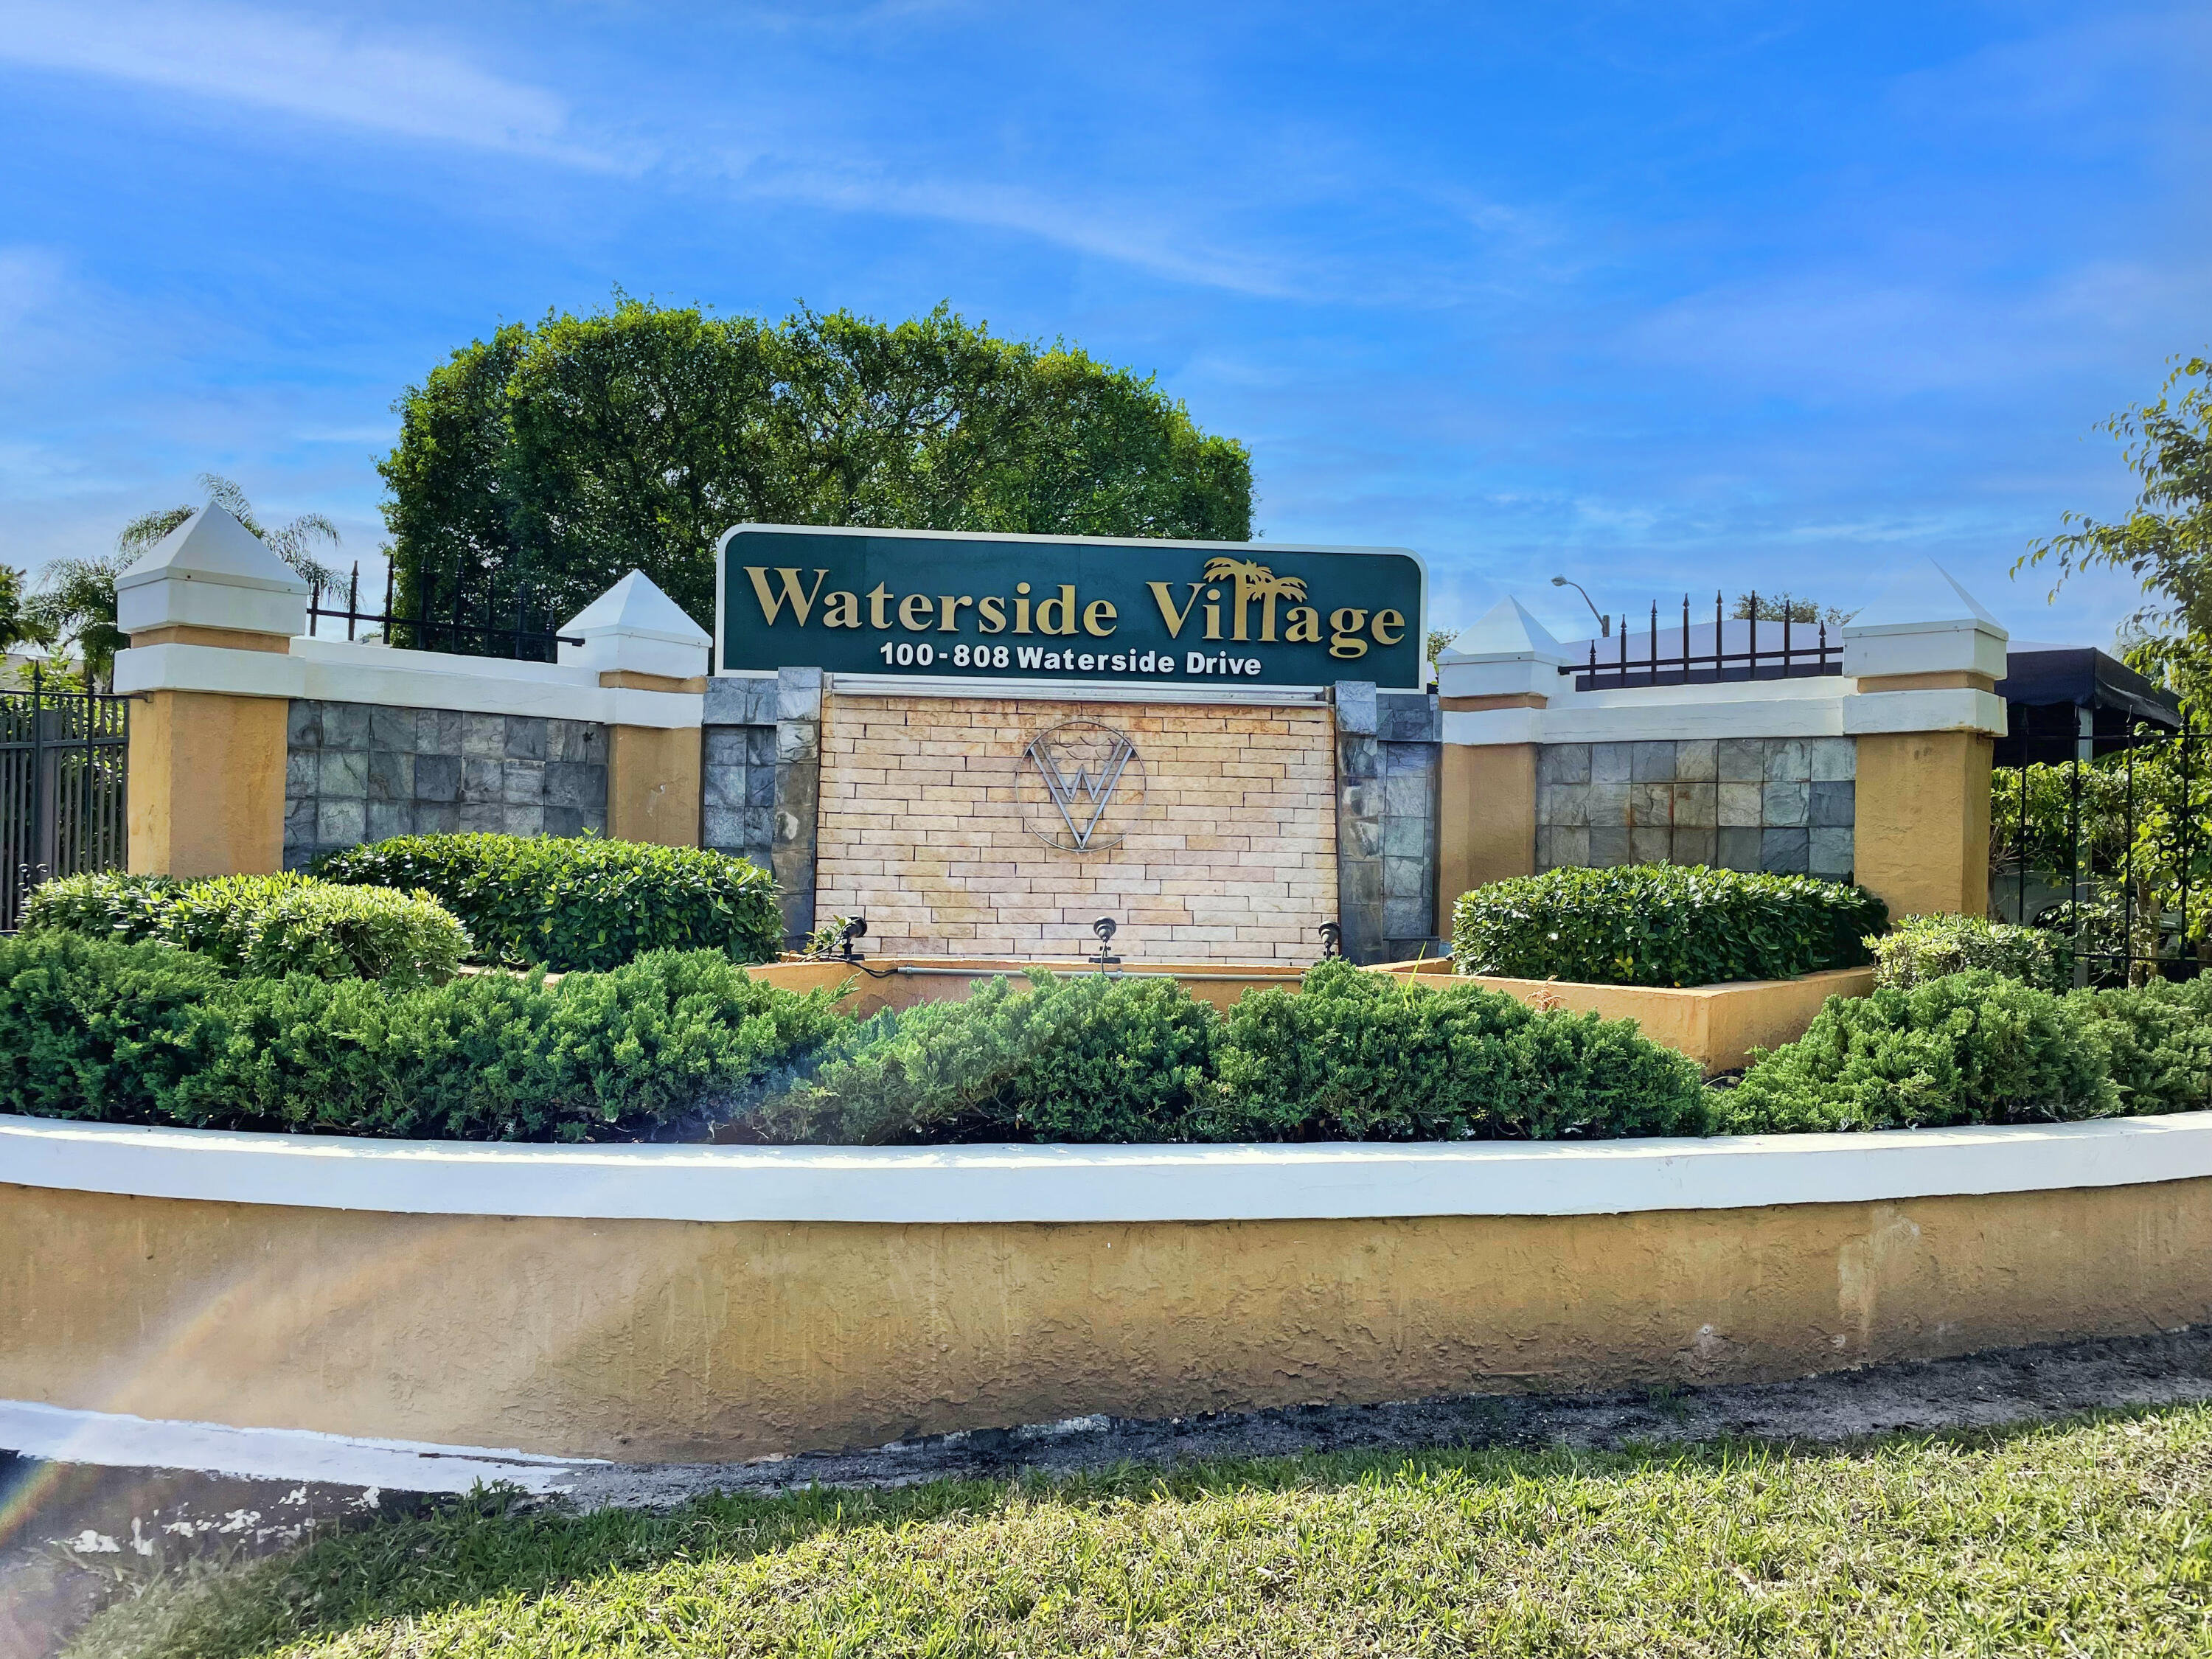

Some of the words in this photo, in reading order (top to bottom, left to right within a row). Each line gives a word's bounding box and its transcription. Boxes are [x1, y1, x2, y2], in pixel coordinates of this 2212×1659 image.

[743, 566, 1118, 637] Waterside
[1146, 557, 1405, 658] Village
[880, 642, 1009, 669] 100-808
[1017, 647, 1175, 674] Waterside
[1186, 652, 1262, 676] Drive
